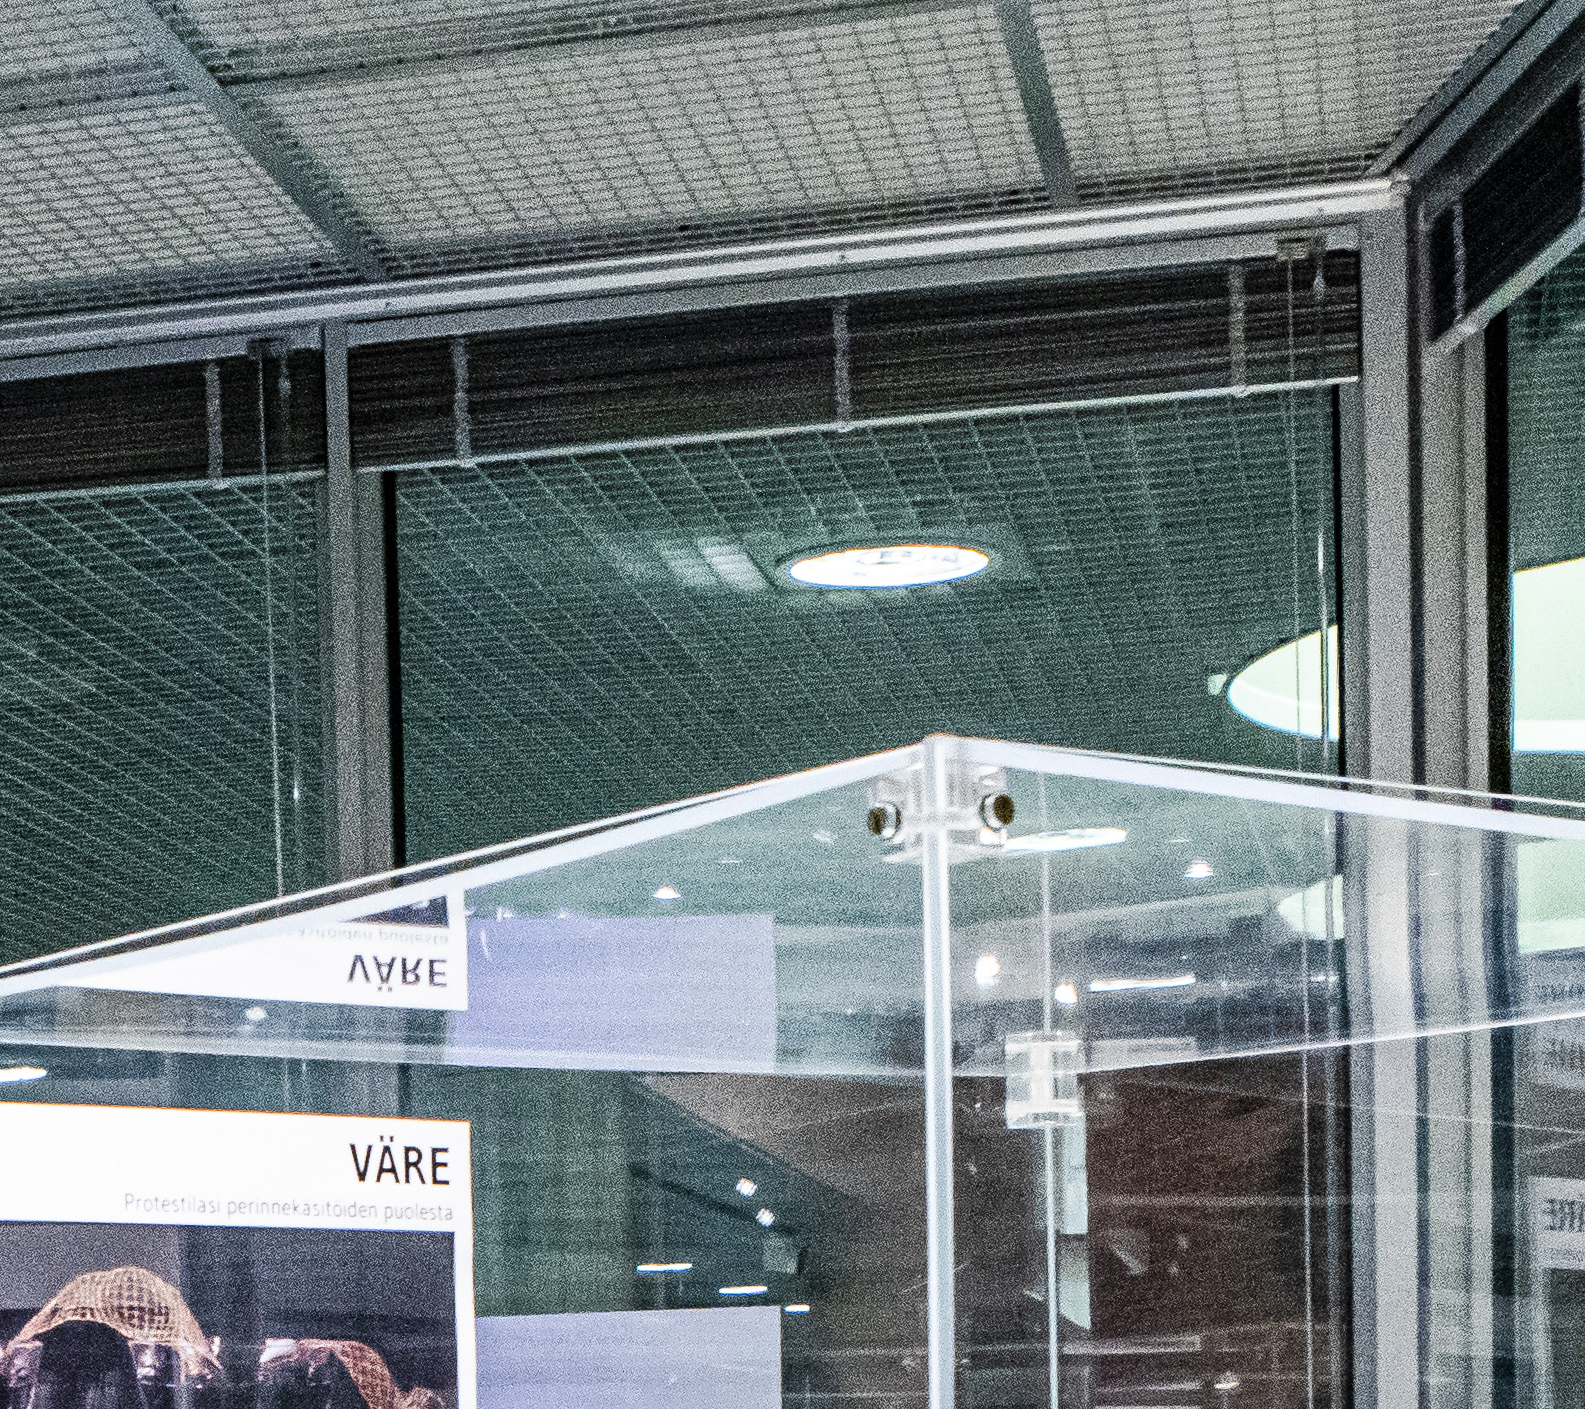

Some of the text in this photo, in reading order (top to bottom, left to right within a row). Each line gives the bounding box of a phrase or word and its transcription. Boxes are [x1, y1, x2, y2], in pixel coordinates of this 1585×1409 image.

[349, 1135, 451, 1187] VÄRE
[124, 1192, 454, 1222] Protestilasi perinnekäsitöiden puolesta
